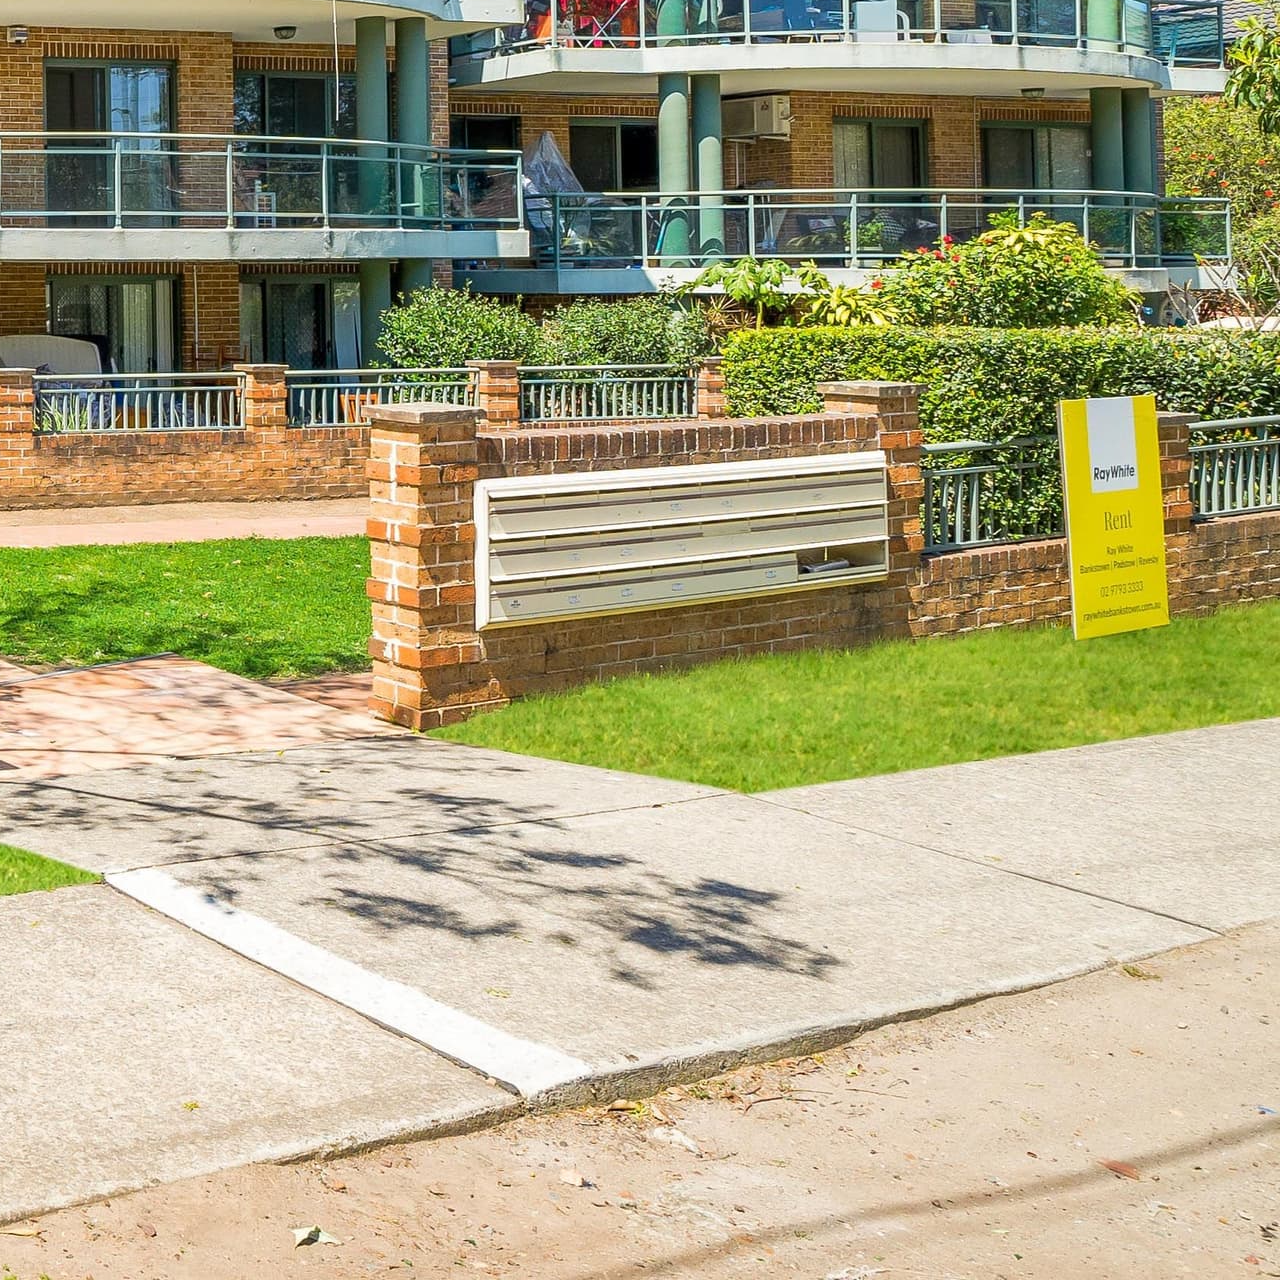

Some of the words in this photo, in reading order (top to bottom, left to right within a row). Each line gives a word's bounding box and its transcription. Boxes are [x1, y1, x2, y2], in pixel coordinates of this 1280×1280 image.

[1104, 509, 1133, 531] Rent
[1106, 546, 1117, 556] Ray
[1117, 544, 1134, 554] White
